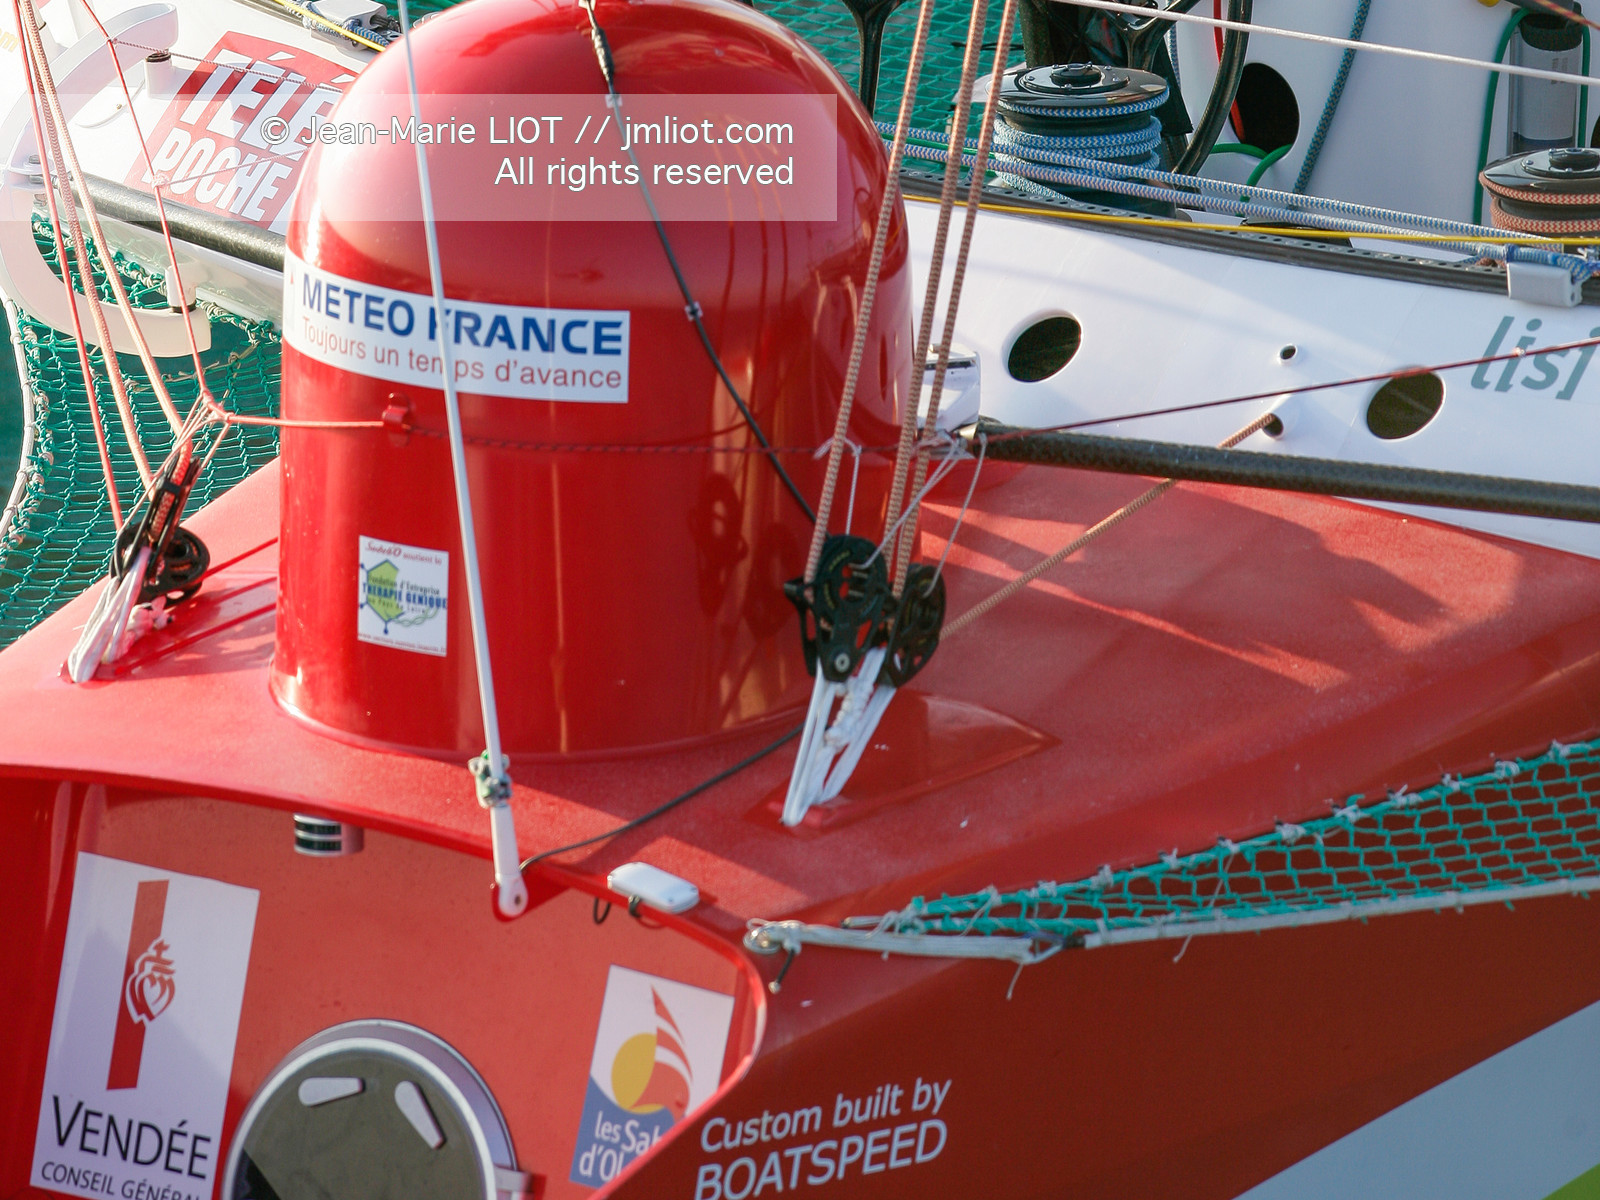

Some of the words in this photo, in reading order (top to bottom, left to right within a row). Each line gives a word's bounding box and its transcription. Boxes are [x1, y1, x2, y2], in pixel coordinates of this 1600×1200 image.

[141, 126, 293, 223] POCHE
[302, 272, 416, 337] METEO
[428, 306, 624, 356] FRANCE
[302, 315, 367, 359] Toujours
[373, 345, 399, 367] un
[494, 359, 623, 389] d'avance
[52, 1094, 212, 1180] VENDÉE
[594, 1110, 622, 1143] les
[701, 1112, 822, 1153] Custom
[832, 1083, 904, 1129] built
[911, 1077, 952, 1115] by
[41, 1161, 115, 1196] CONSEIL
[693, 1118, 949, 1200] BOATSPEED
